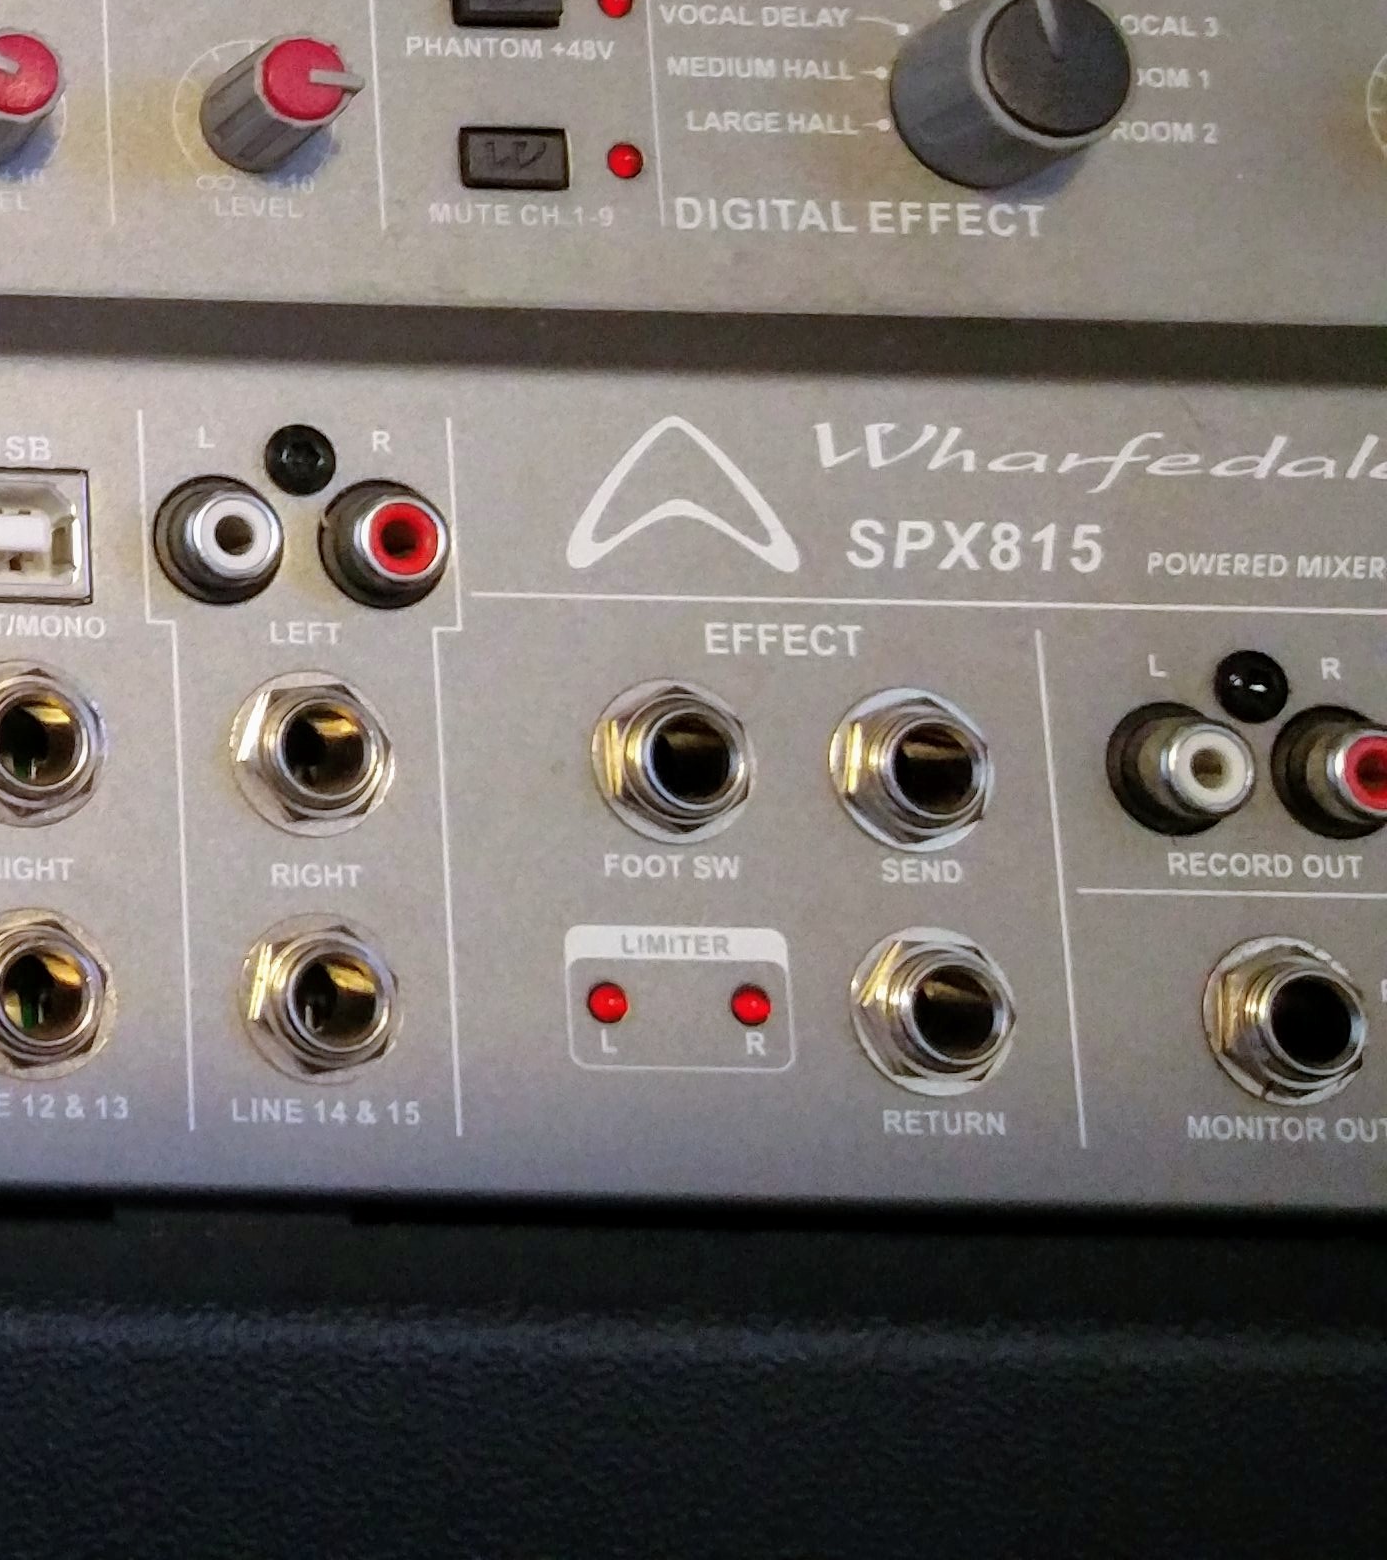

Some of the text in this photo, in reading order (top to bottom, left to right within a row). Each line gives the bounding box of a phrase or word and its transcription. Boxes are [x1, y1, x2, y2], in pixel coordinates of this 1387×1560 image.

[659, 6, 851, 28] VOCAL DELAY
[1120, 14, 1219, 37] OCAL 3
[406, 38, 614, 60] PHANTOM +48V
[667, 57, 855, 80] MEDIUM HALL
[687, 111, 858, 133] LARGE HALL
[1203, 123, 1218, 144] 2
[429, 204, 510, 224] MUTE
[575, 206, 614, 227] 1-9
[674, 196, 1045, 237] DIGITAL EFFECT
[199, 428, 391, 453] L R
[846, 519, 1105, 574] SPX815
[1146, 551, 1387, 579] POWERED MIXER
[270, 621, 341, 644] LEFT
[704, 623, 862, 657] EFFECT
[1149, 656, 1341, 679] L R
[271, 864, 361, 888] RIGHT
[604, 854, 740, 879] FOOT SW
[882, 857, 963, 884] SEND
[1167, 852, 1363, 879] RECORD OUT
[621, 933, 730, 956] LIMITER
[601, 1033, 766, 1056] L R
[22, 1094, 57, 1118] 12
[66, 1095, 87, 1120] &
[95, 1095, 129, 1119] 13
[232, 1100, 419, 1126] LINE 14 & 15
[882, 1110, 1006, 1137] RETURN
[1186, 1114, 1326, 1141] MONITOR
